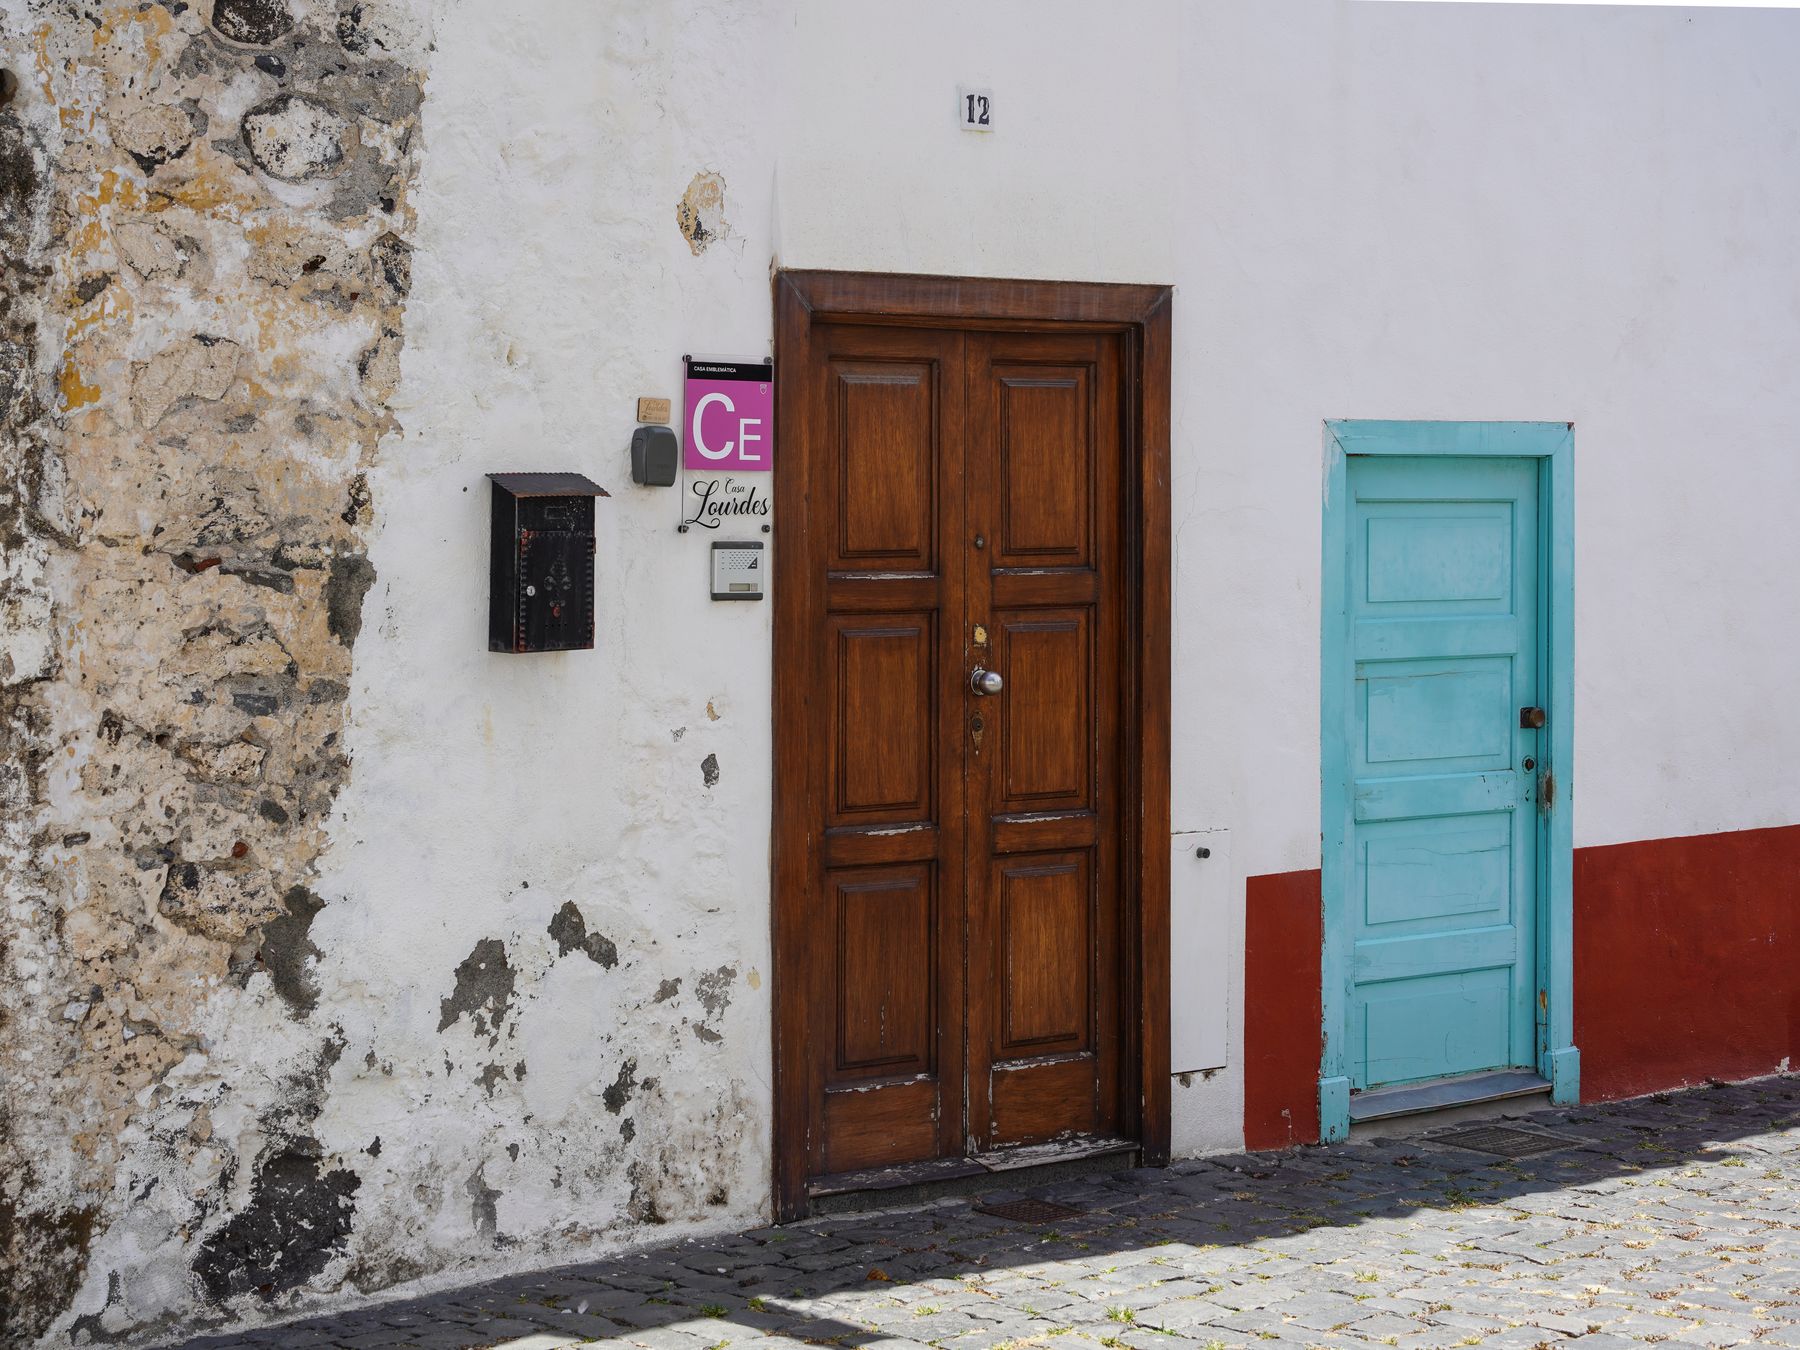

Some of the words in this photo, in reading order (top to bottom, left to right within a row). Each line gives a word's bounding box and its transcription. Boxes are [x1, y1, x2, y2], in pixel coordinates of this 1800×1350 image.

[966, 94, 990, 125] 12
[725, 478, 745, 494] Casa
[685, 480, 771, 529] Lourdes
